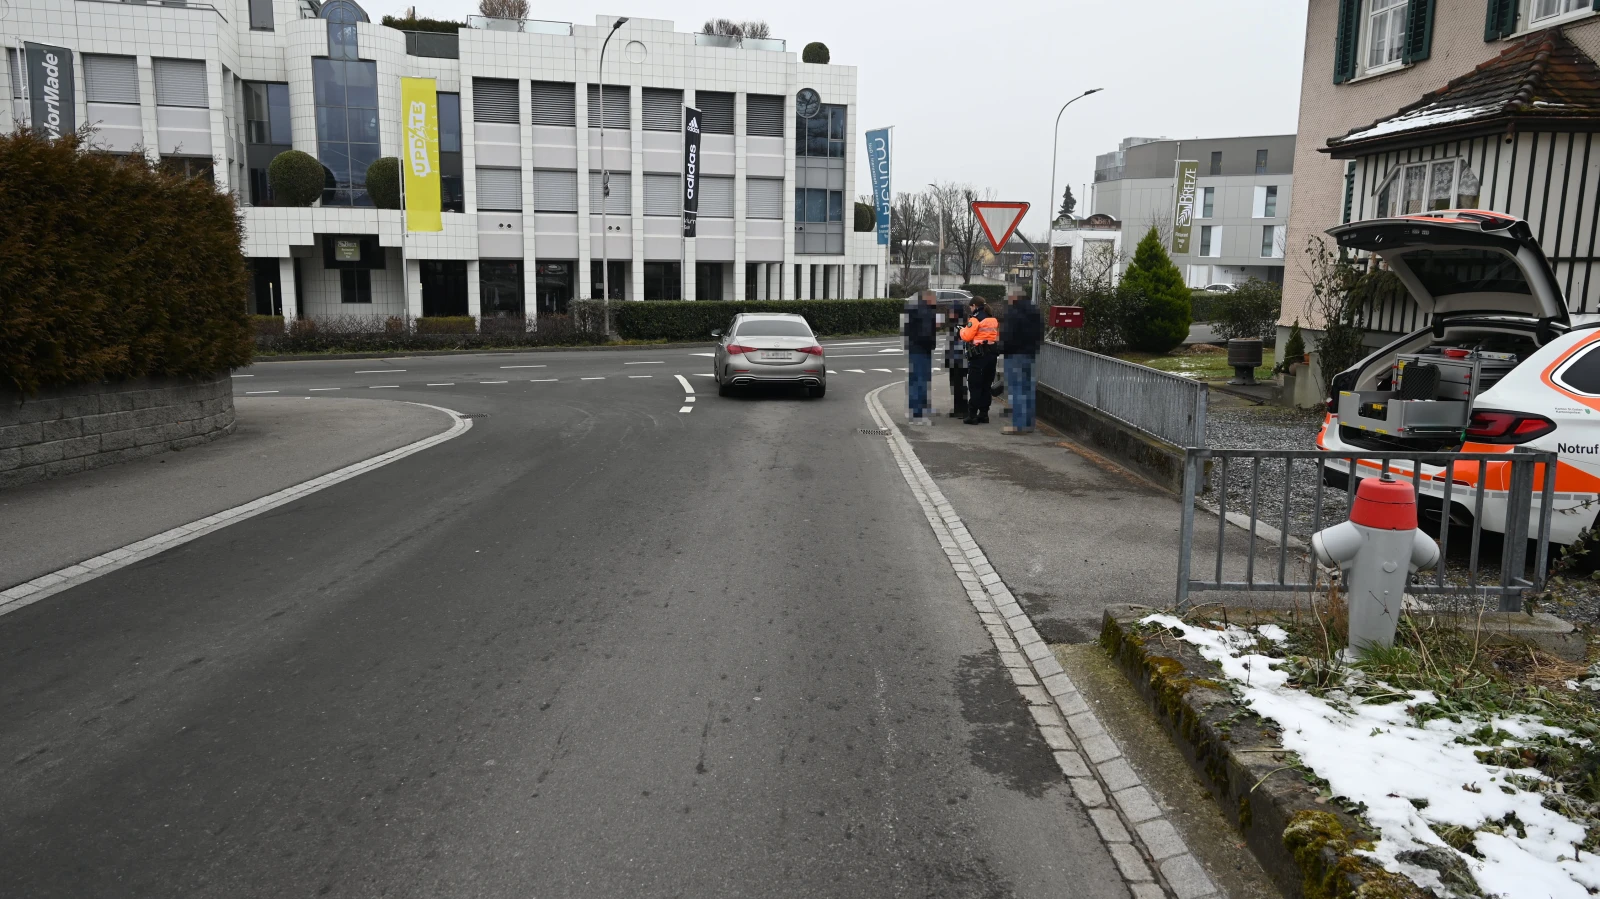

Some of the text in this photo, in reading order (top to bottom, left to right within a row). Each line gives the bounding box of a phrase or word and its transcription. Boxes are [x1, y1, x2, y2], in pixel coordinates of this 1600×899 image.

[42, 53, 61, 141] ylorMade
[687, 126, 699, 134] adidas
[687, 144, 697, 199] adidas
[1557, 442, 1599, 455] Notruf
